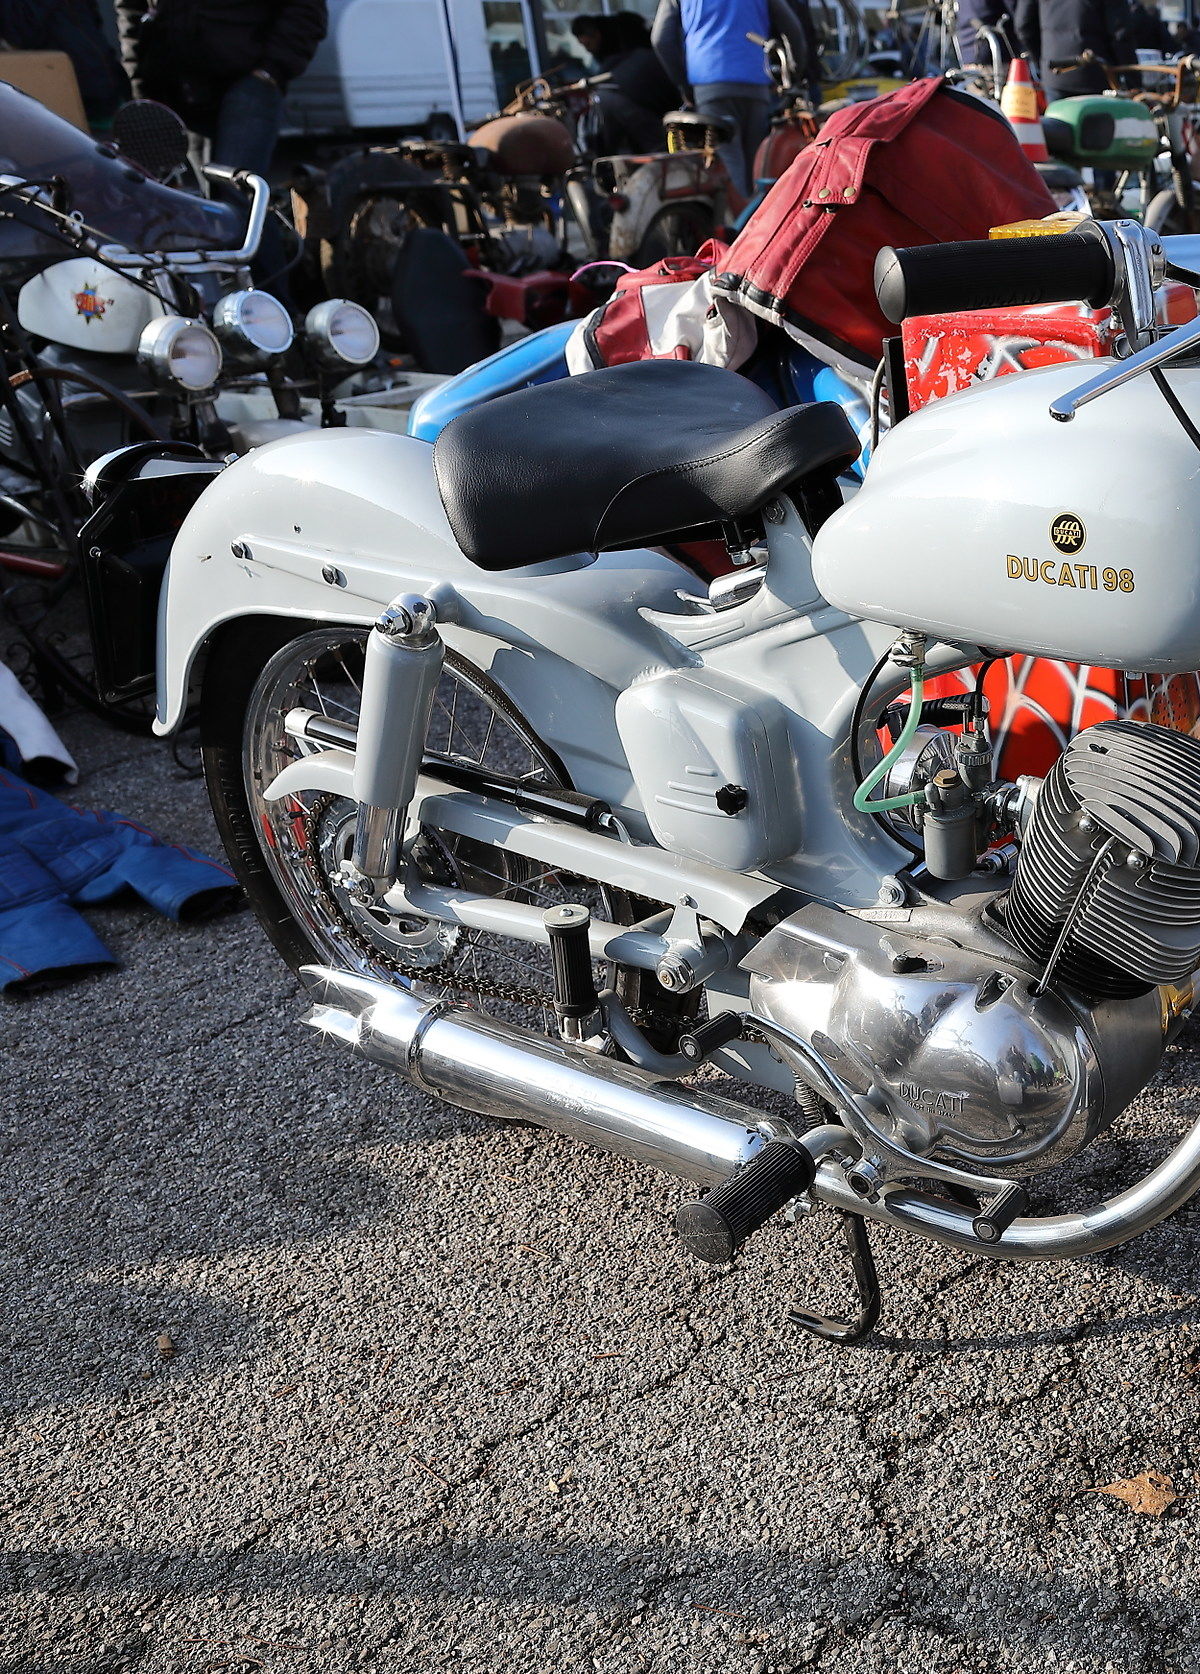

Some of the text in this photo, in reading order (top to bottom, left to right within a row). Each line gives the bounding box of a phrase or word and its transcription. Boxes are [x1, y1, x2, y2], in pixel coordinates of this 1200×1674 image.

[1055, 528, 1080, 538] DUCATI
[1006, 554, 1135, 593] DUCATI 98
[900, 1081, 967, 1113] DUCATI
